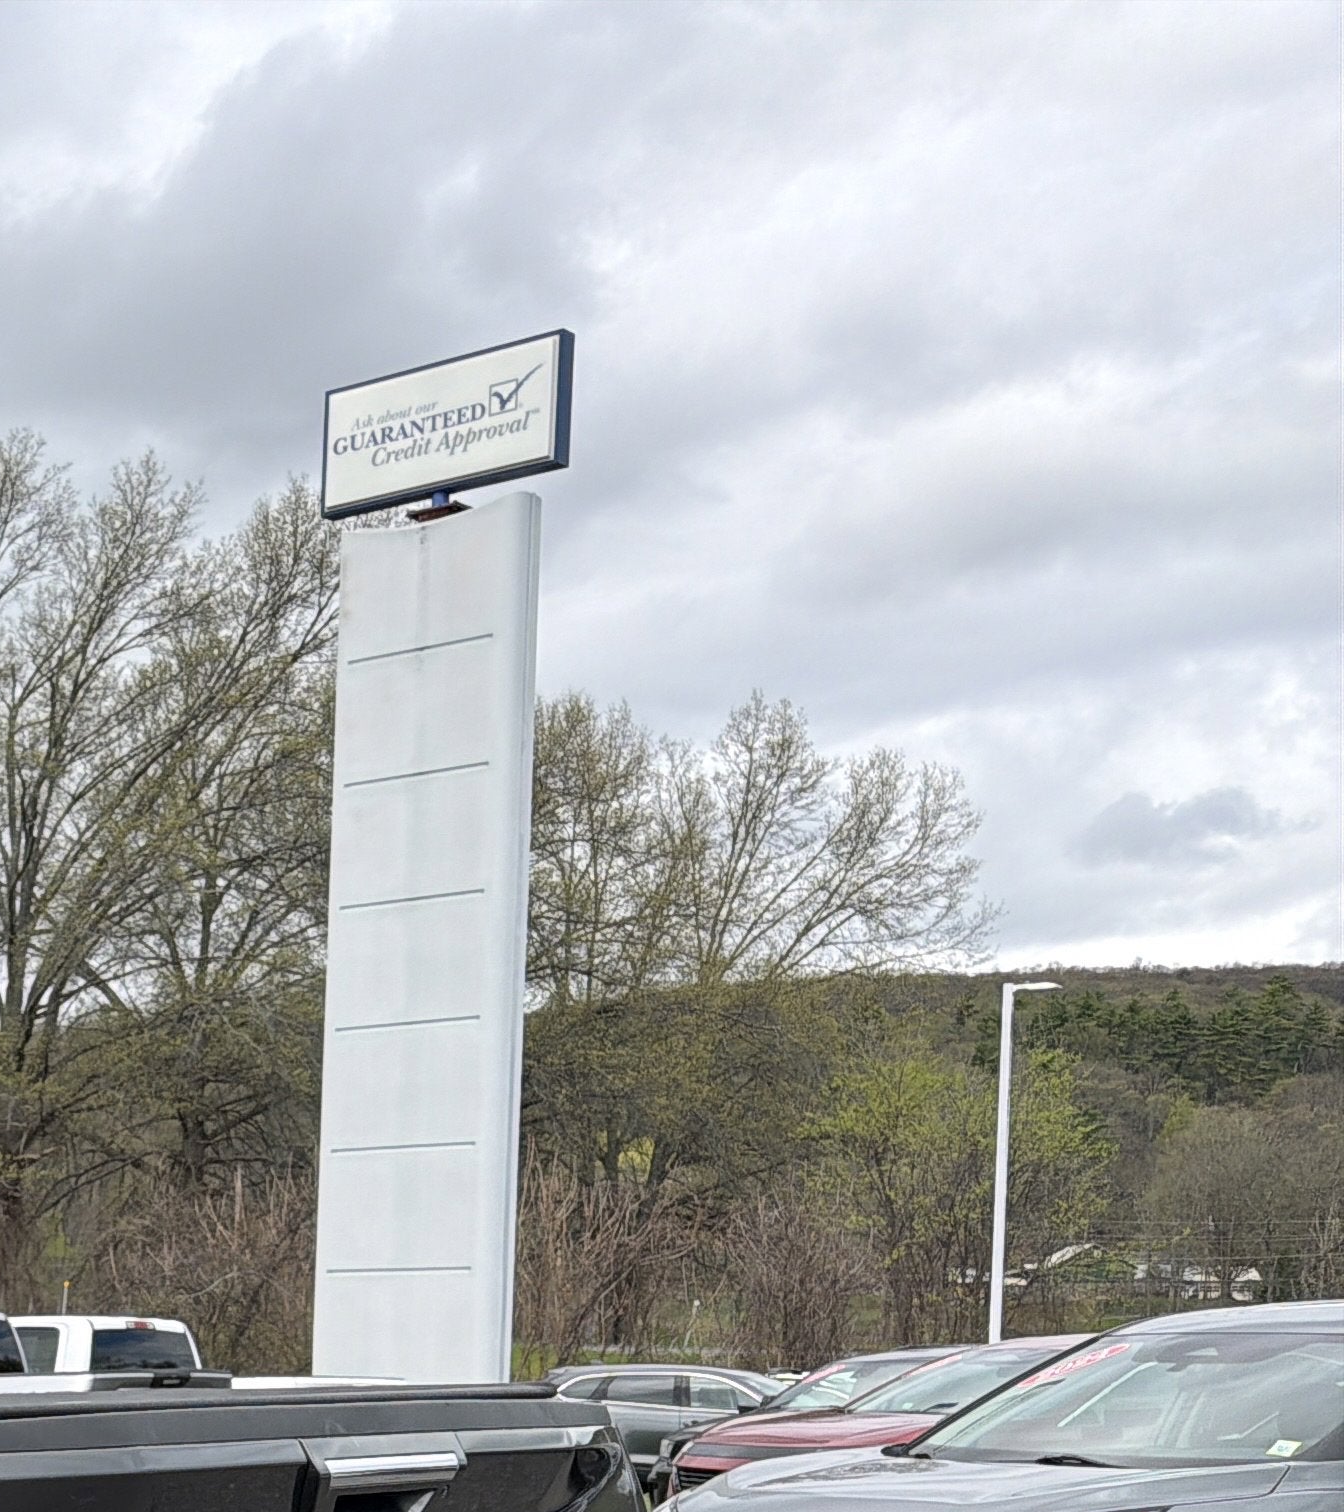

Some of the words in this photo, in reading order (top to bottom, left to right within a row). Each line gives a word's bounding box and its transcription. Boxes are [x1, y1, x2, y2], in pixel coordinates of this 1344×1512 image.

[333, 403, 486, 455] GUARANTEED
[352, 418, 373, 431] Ask
[377, 407, 411, 425] about
[415, 402, 437, 415] our
[371, 438, 432, 467] Credit
